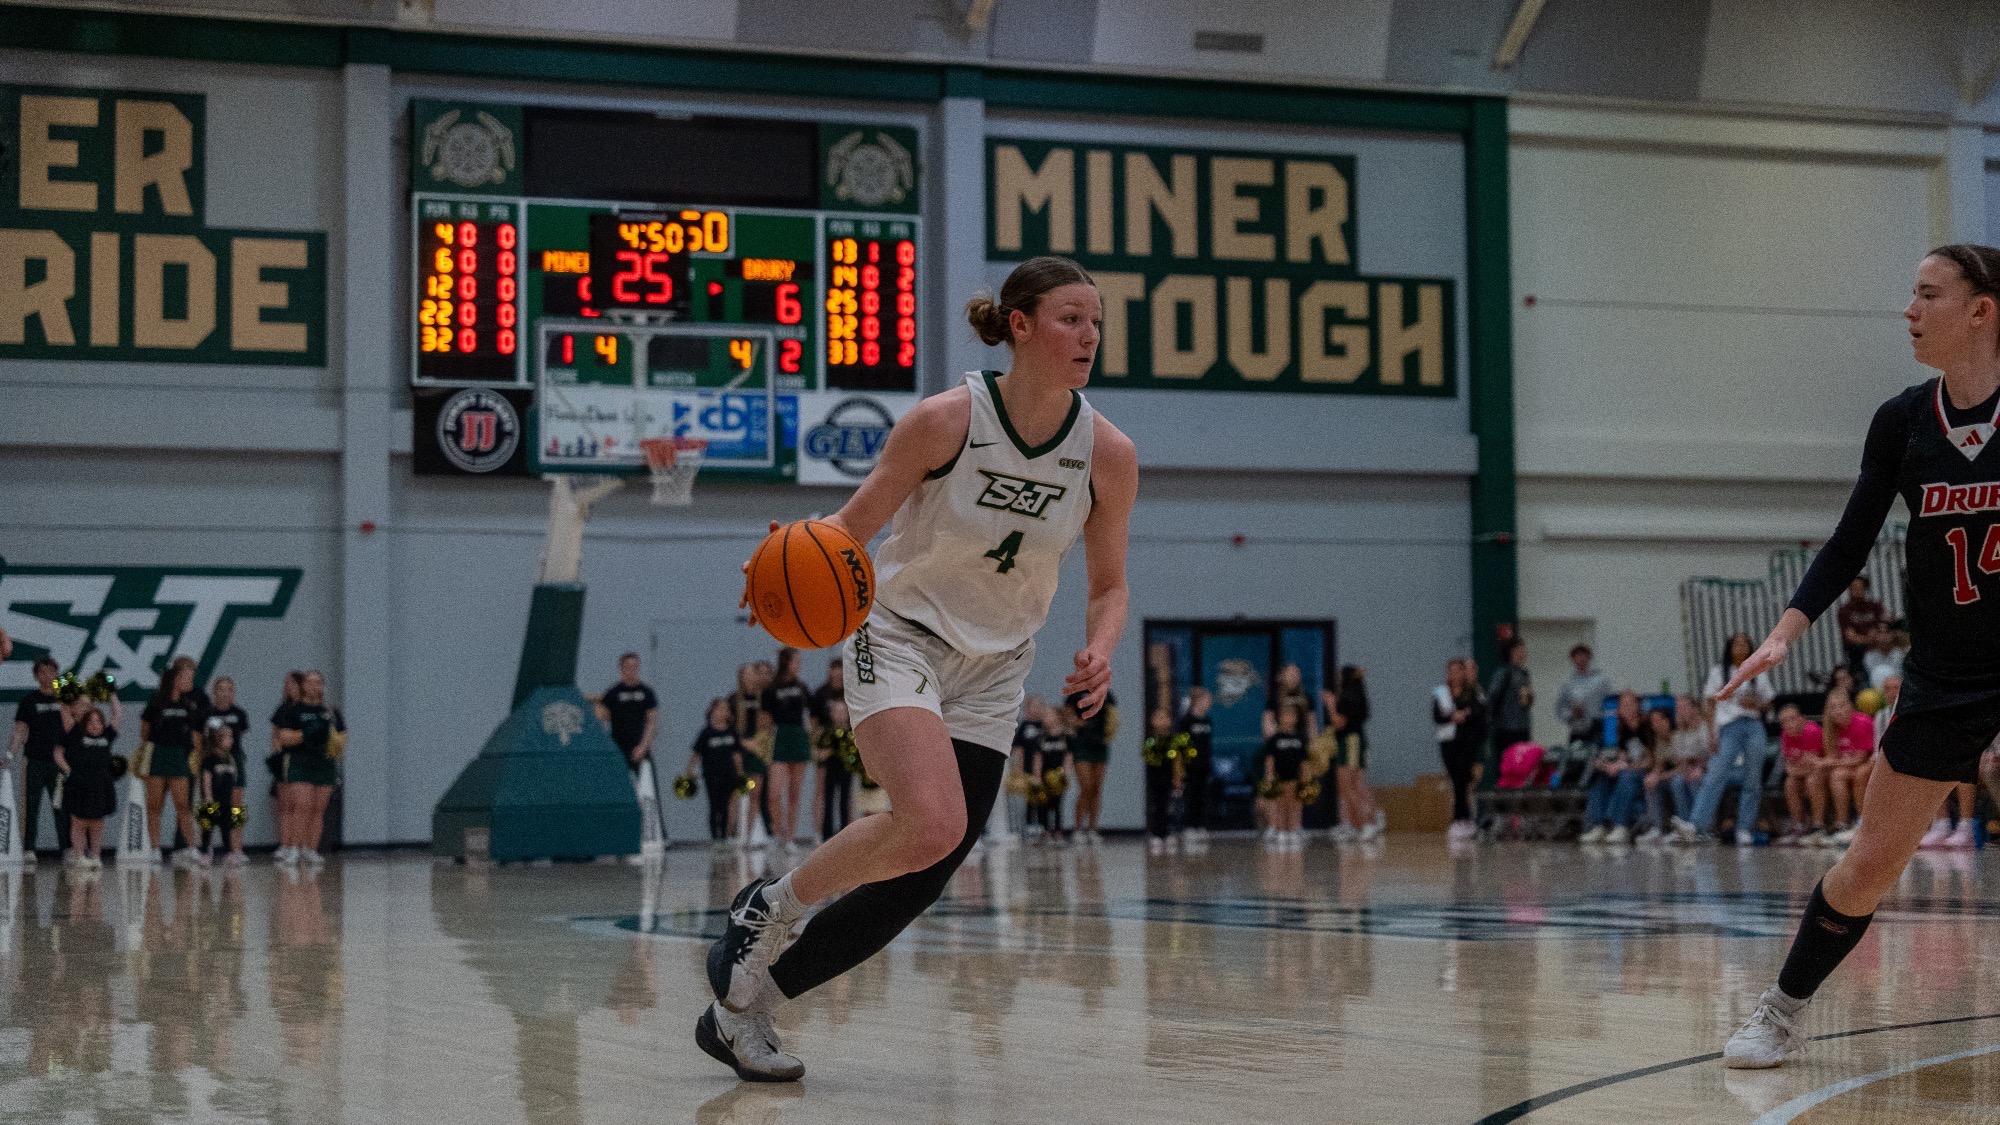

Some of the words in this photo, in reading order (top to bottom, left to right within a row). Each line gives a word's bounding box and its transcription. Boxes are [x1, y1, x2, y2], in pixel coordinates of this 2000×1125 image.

[19, 94, 194, 216] ER
[994, 145, 1350, 265] MINER
[435, 223, 453, 244] 4
[458, 222, 477, 247] 0
[497, 224, 516, 249] 0
[618, 221, 684, 253] 4:50
[435, 248, 453, 273] 6
[458, 249, 477, 274] 0
[497, 251, 516, 275] 0
[868, 242, 880, 263] 1
[897, 240, 915, 266] 0
[0, 227, 308, 352] RIDE
[427, 274, 453, 299] 12
[458, 276, 477, 300] 0
[497, 277, 516, 301] 0
[612, 251, 673, 303] 25
[861, 264, 880, 290] 0
[897, 267, 915, 291] 2
[419, 300, 453, 325] 22
[458, 301, 477, 327] 0
[497, 303, 516, 328] 0
[775, 283, 801, 324] 6
[861, 290, 880, 315] 0
[897, 292, 915, 316] 0
[421, 326, 453, 352] 32
[458, 328, 477, 353] 0
[497, 329, 516, 355] 0
[861, 315, 880, 340] 0
[897, 317, 915, 341] 0
[1087, 270, 1444, 387] TOUGH
[563, 335, 574, 363] 1
[594, 335, 617, 365] 4
[729, 339, 751, 369] 4
[780, 339, 802, 373] 2
[861, 341, 880, 366] 0
[897, 341, 915, 368] 2
[977, 468, 1067, 519] S&T
[983, 529, 1025, 575] 4
[1945, 523, 2000, 605] 14
[841, 548, 868, 611] NCAA
[0, 574, 283, 690] S&T
